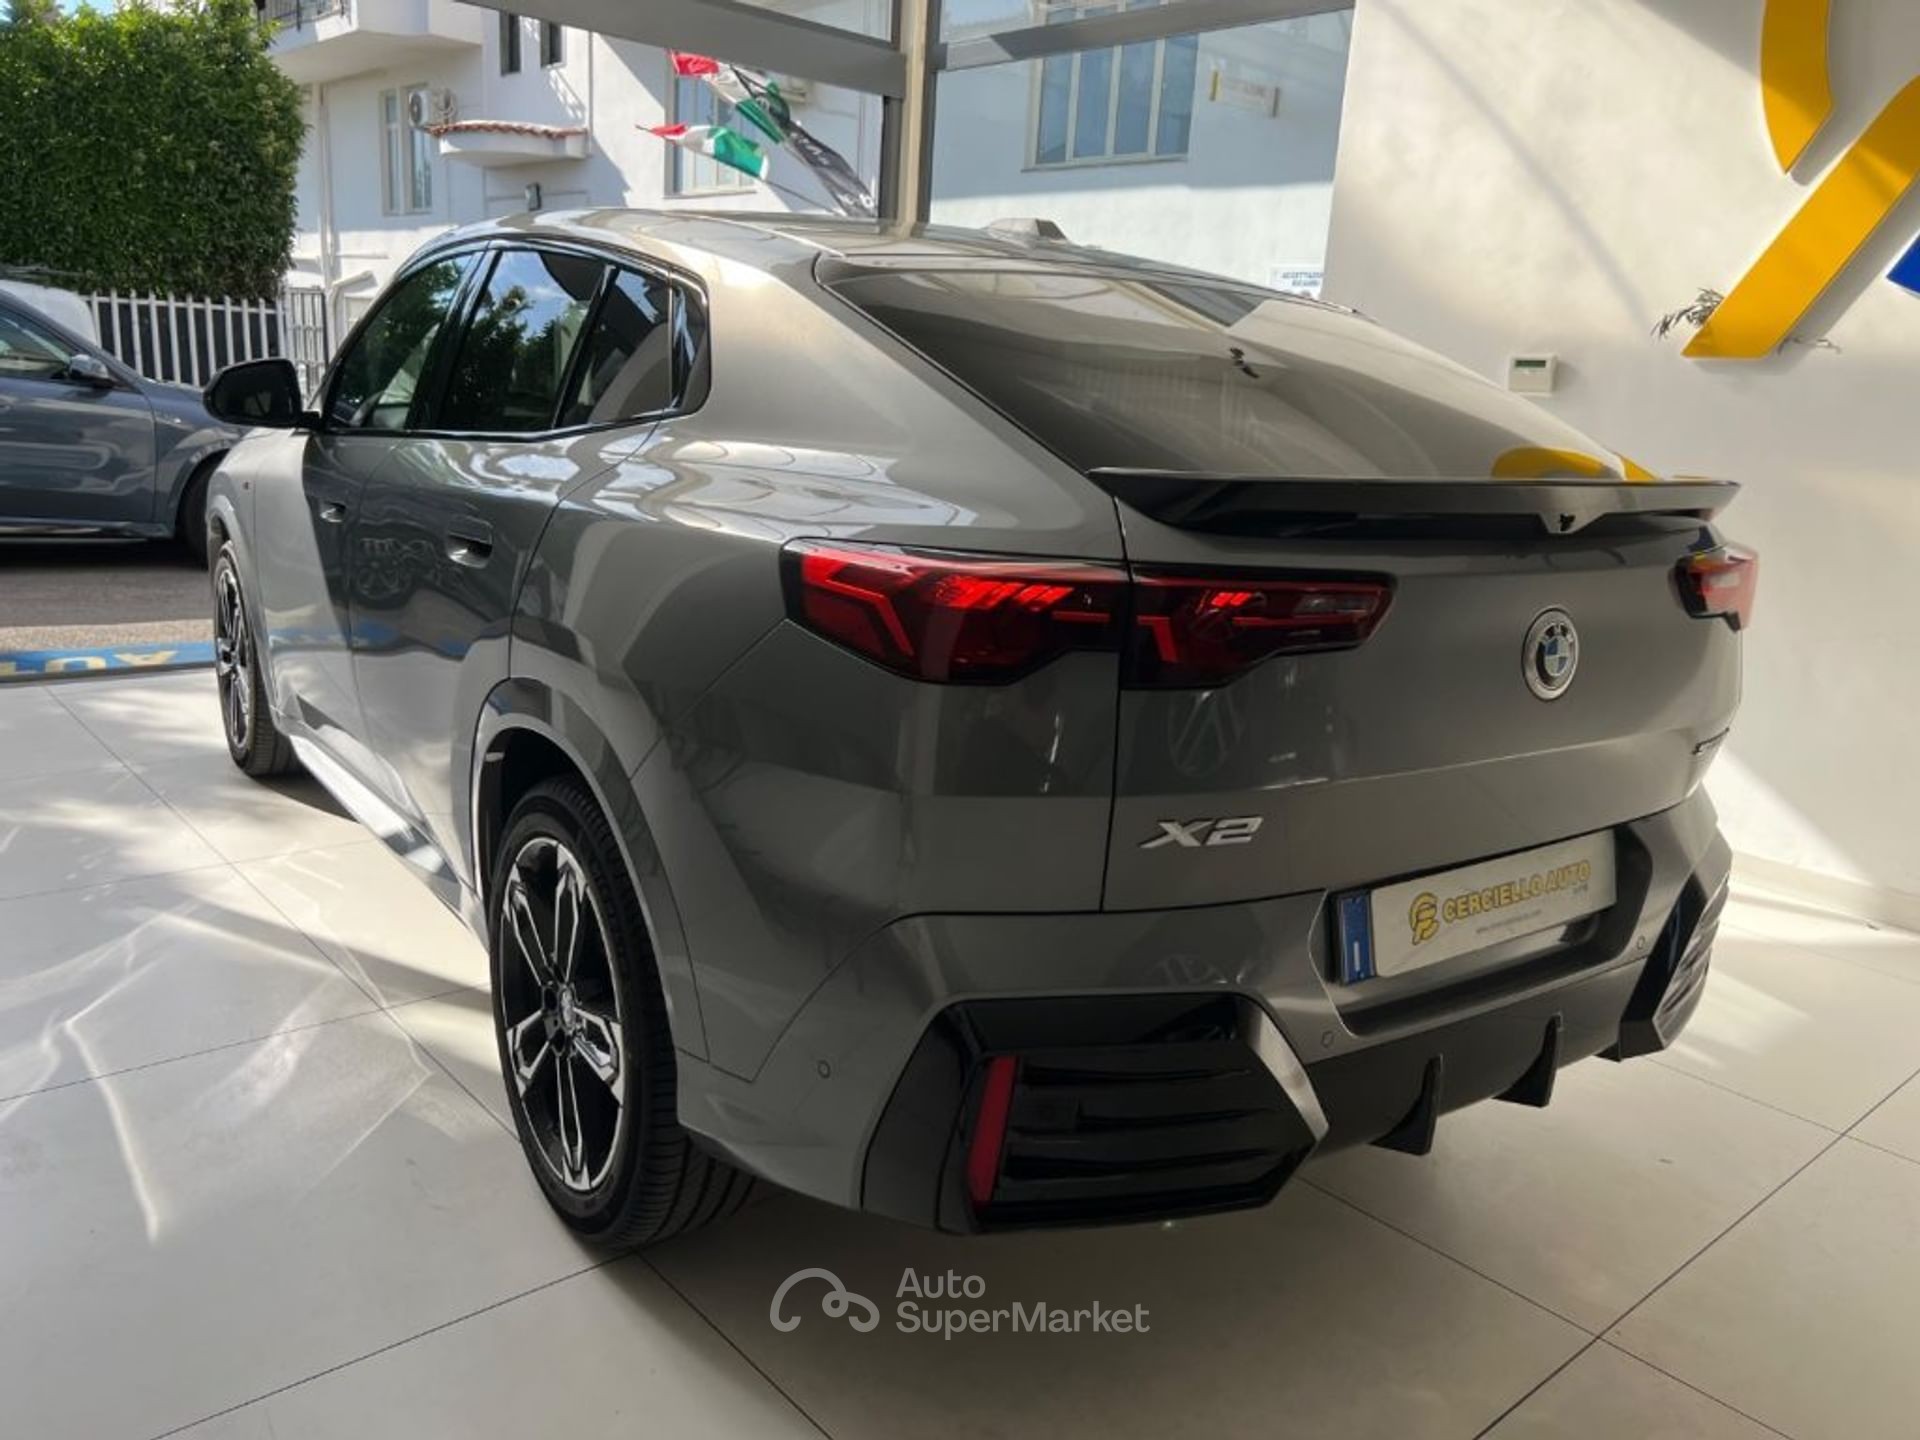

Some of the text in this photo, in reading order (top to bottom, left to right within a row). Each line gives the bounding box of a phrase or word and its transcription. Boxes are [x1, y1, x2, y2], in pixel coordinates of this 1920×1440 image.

[1139, 816, 1264, 849] X2
[1442, 874, 1543, 924] CERCIELLO
[1543, 859, 1591, 895] AUTO
